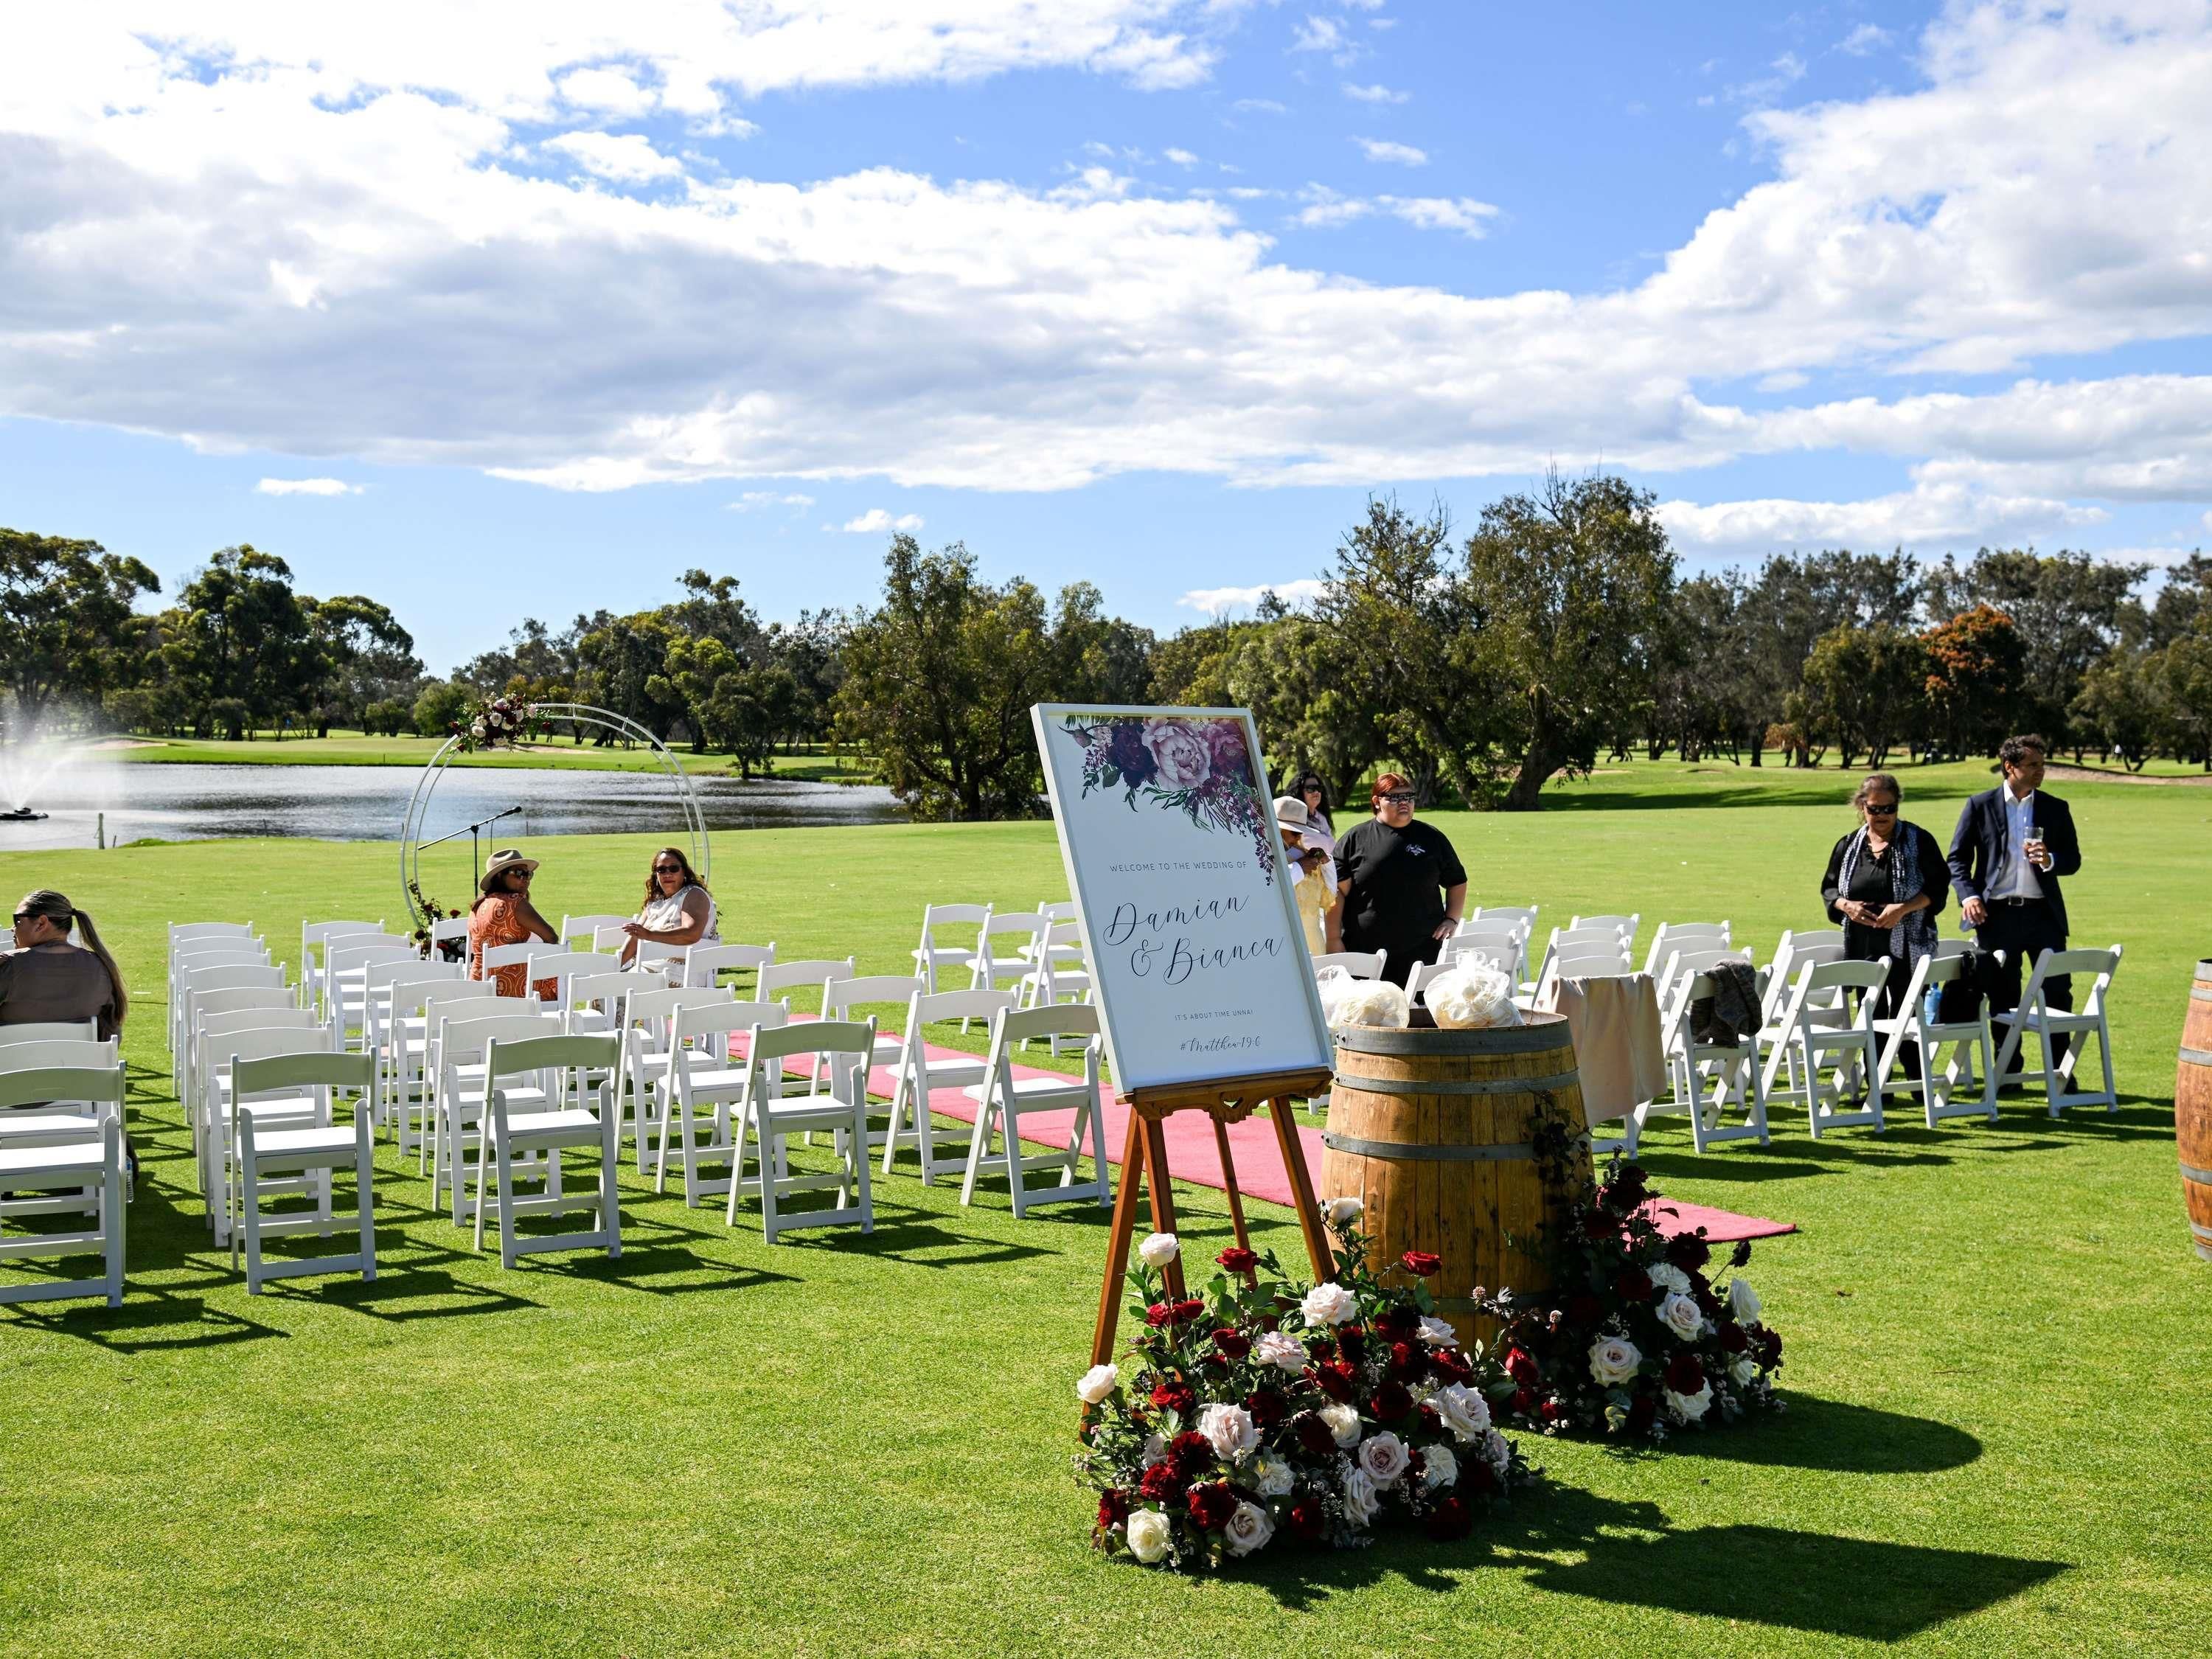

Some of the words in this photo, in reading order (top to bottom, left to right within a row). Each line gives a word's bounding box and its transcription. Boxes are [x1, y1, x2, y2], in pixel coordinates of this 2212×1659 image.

[1110, 863, 1155, 872] WELCOME
[1174, 862, 1191, 870] THE
[1193, 861, 1234, 869] WEDDING
[1103, 895, 1249, 945] Damian
[1131, 939, 1164, 977] &
[1163, 937, 1284, 985] Bianca
